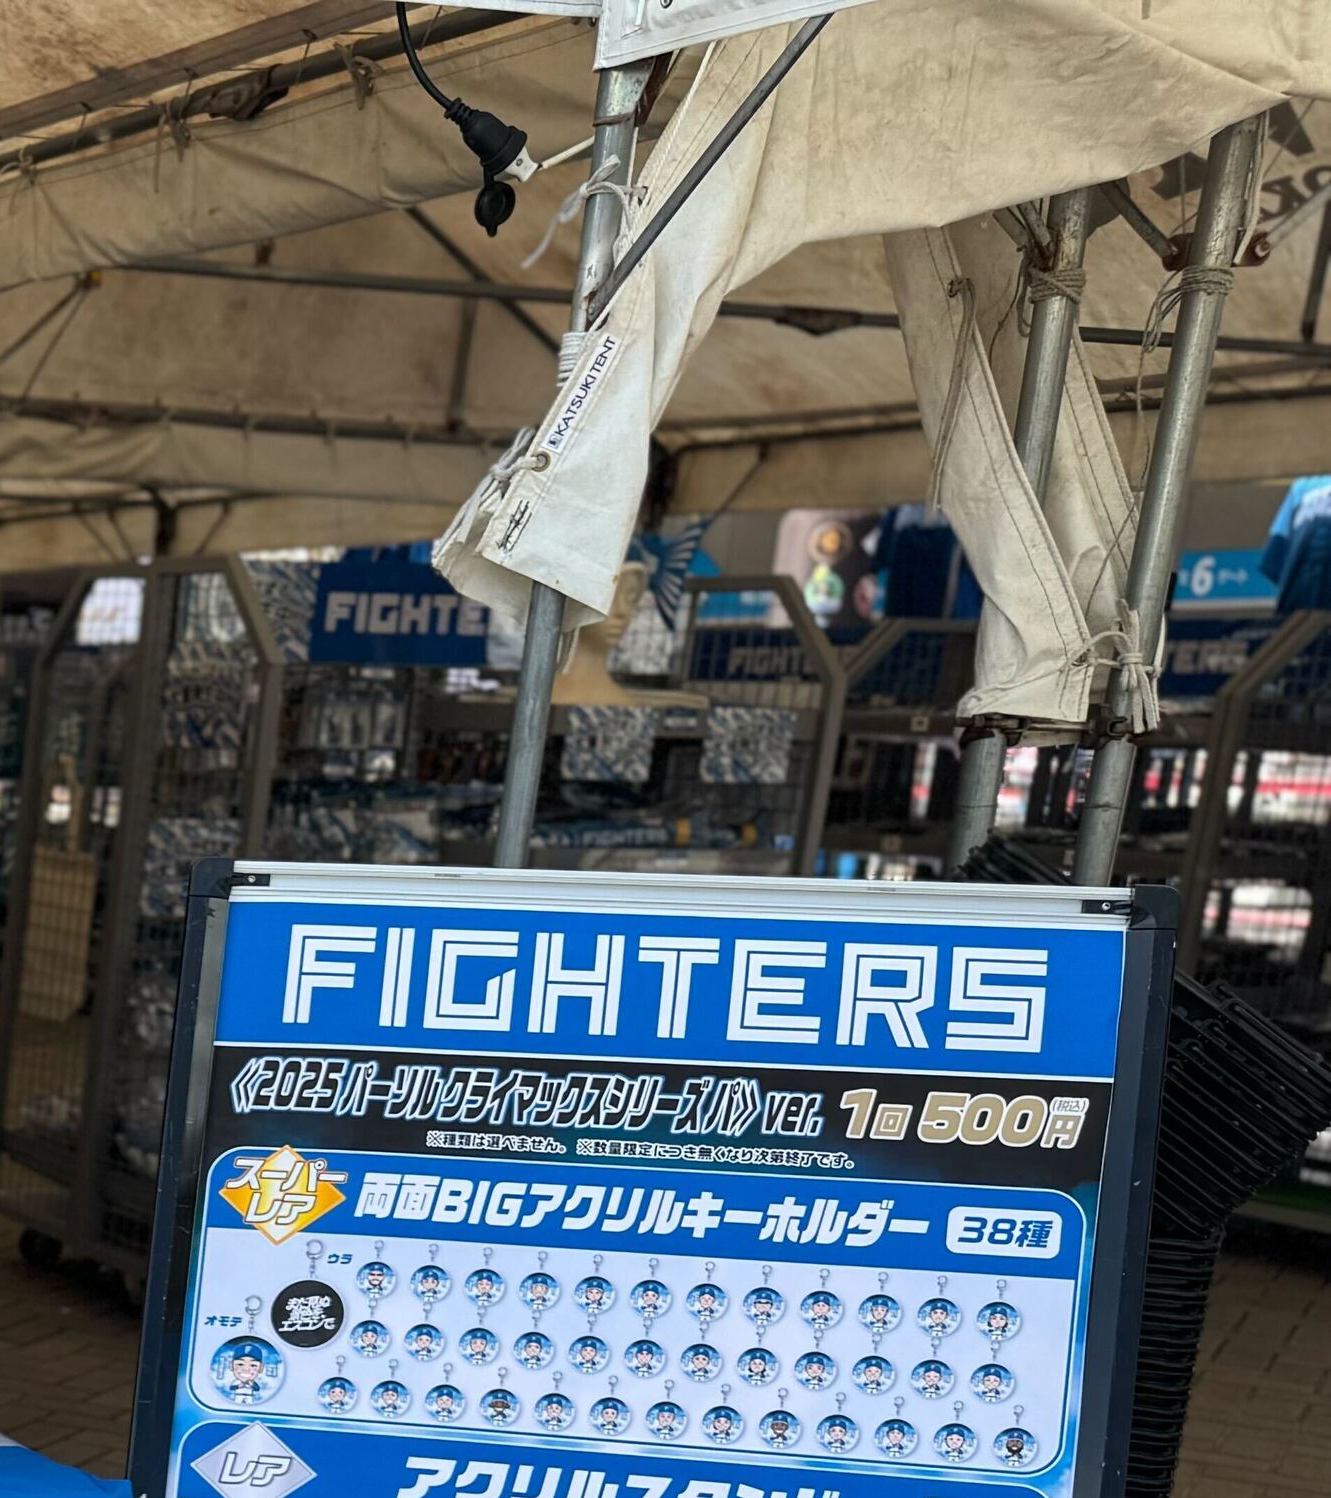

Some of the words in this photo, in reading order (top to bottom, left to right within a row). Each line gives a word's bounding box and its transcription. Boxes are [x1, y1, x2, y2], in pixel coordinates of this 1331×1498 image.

[555, 372, 598, 437] KATSUKI
[589, 336, 616, 375] TENT
[281, 924, 1049, 1053] FIGHTERS
[761, 1089, 825, 1137] ver.
[426, 1130, 567, 1154] ※種類は選べません。
[576, 1138, 855, 1170] ※数量限定につき無くなり次第終了です。
[225, 1154, 348, 1193] スーパー
[242, 1192, 319, 1226] レア
[354, 1171, 930, 1248] 両面BIGアクリルキーホルダー
[957, 1215, 1054, 1250] 38種
[327, 1253, 353, 1265] ウラ
[204, 1315, 243, 1328] オモテ
[219, 1452, 294, 1486] レア
